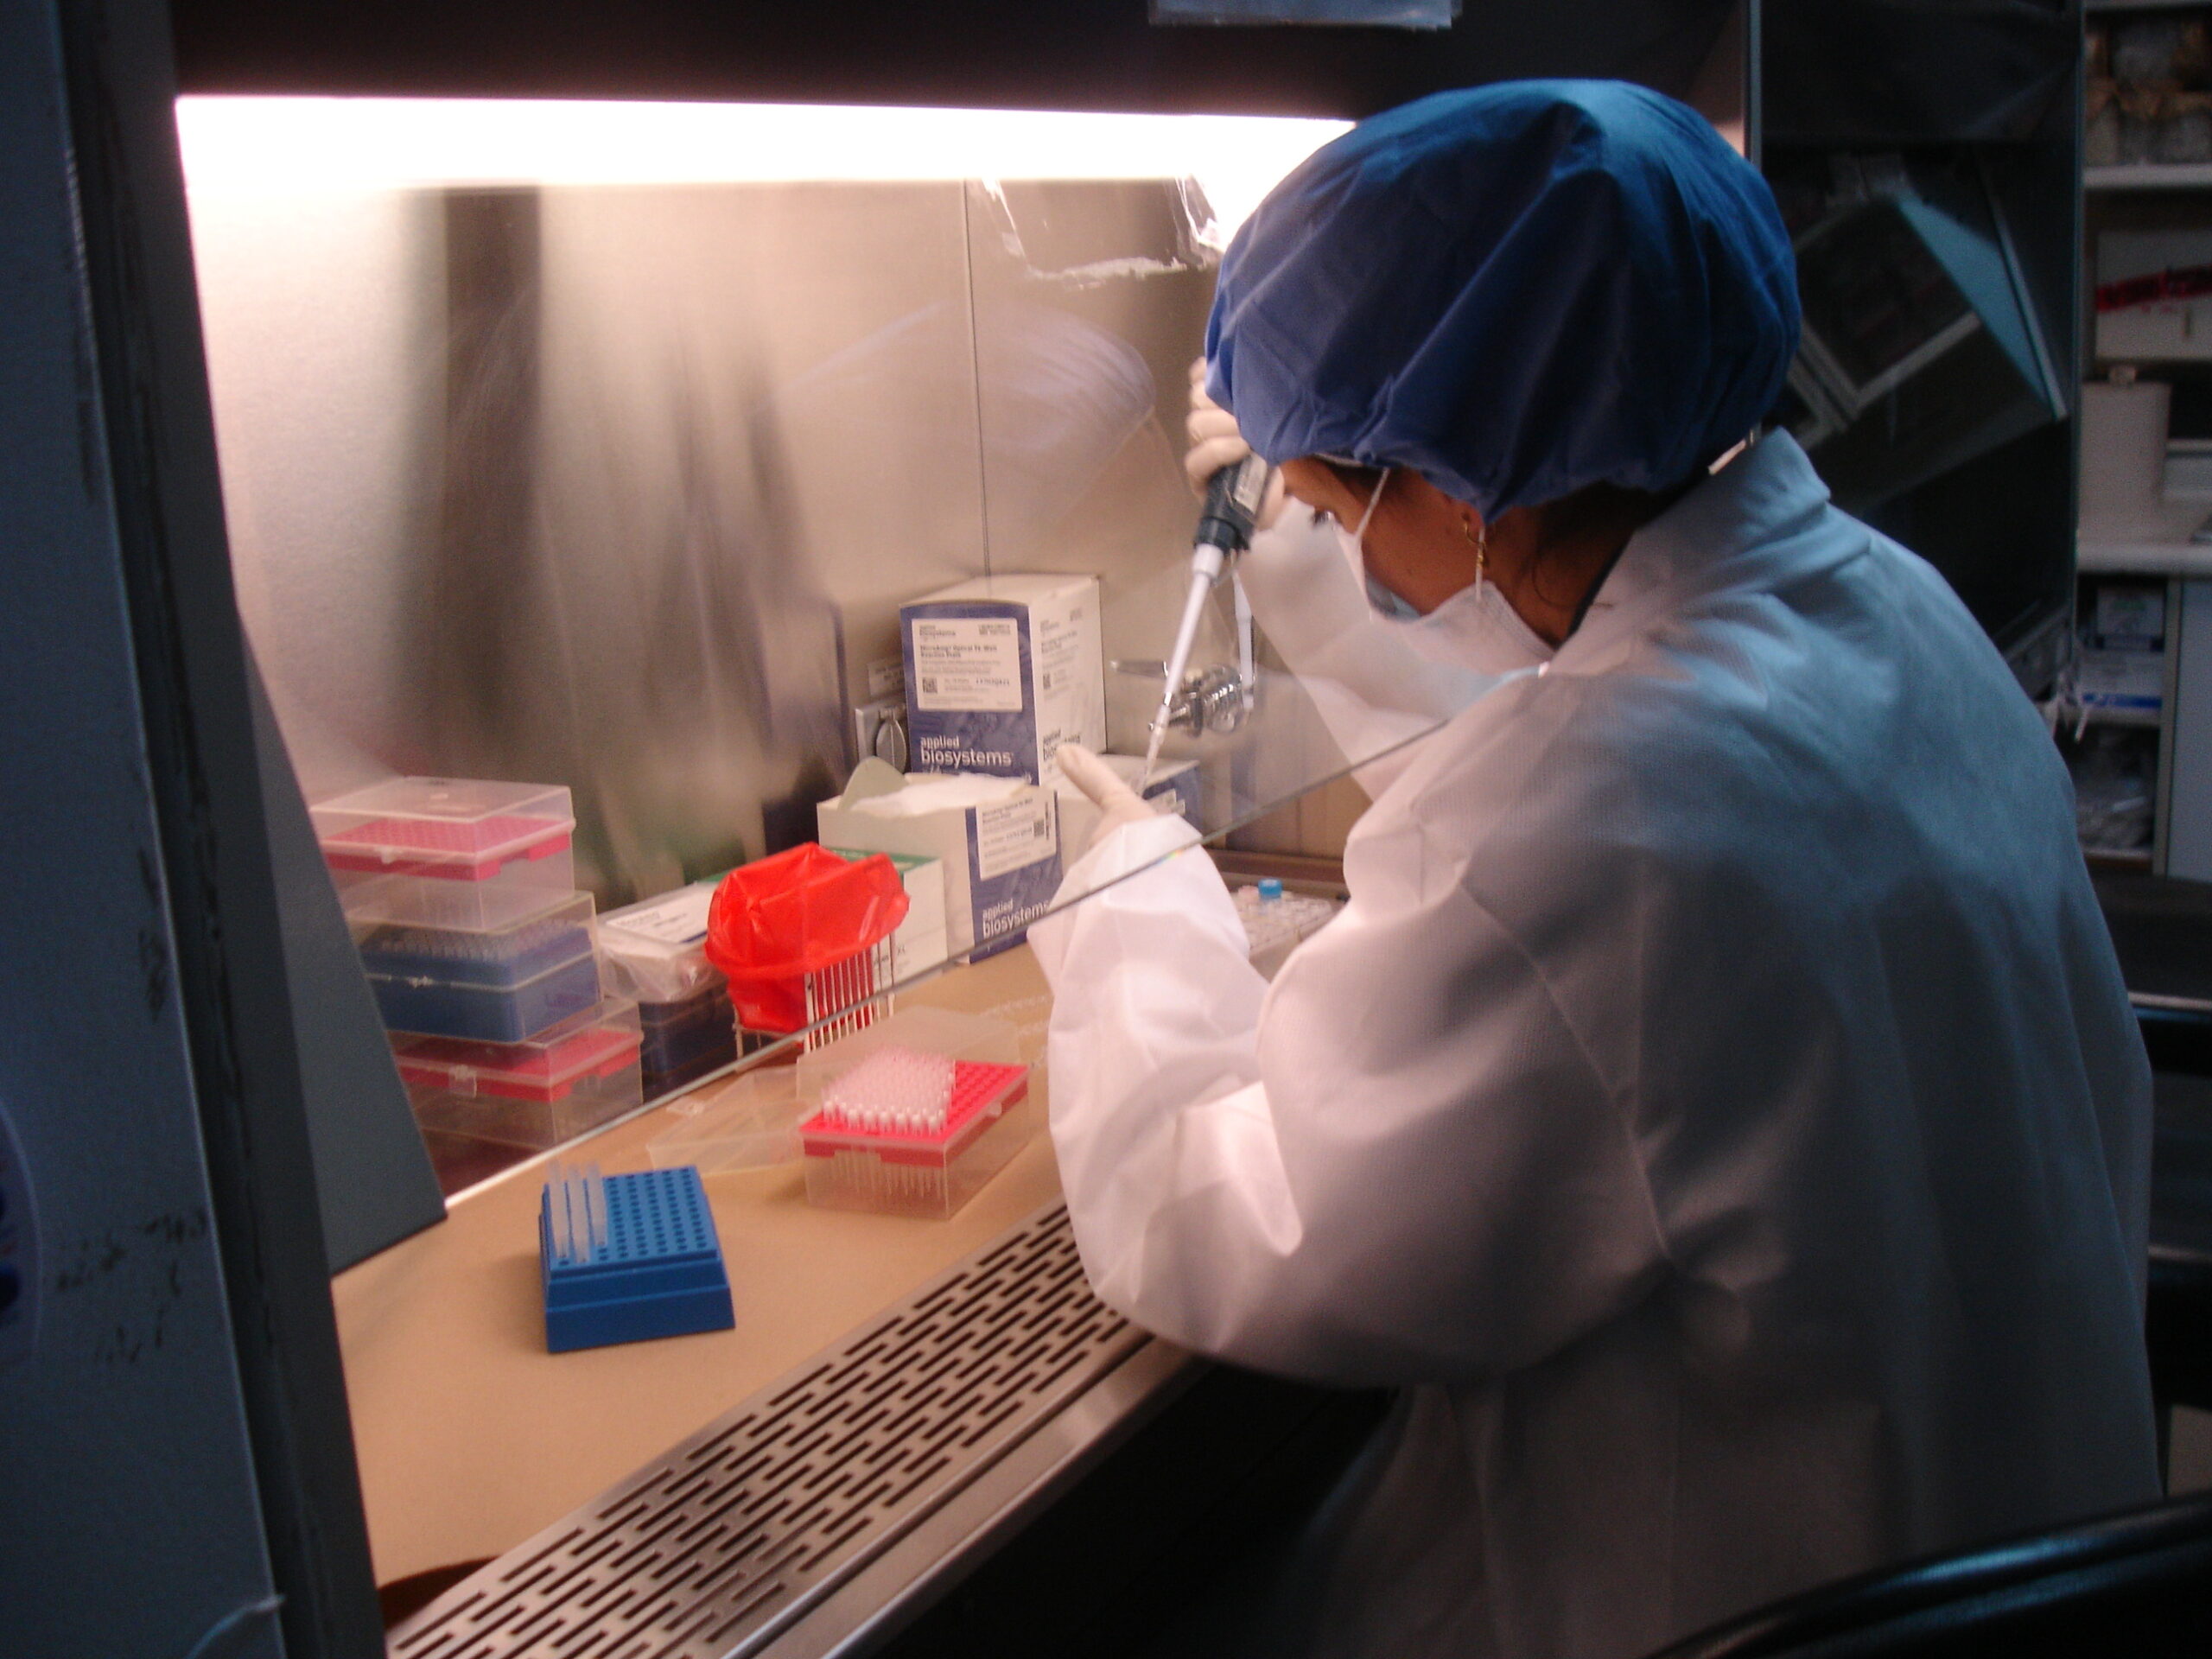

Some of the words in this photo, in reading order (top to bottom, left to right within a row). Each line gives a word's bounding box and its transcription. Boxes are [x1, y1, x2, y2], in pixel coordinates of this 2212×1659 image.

[920, 735, 960, 750] applied
[920, 747, 1012, 769] biosystems
[982, 898, 1014, 920] applied
